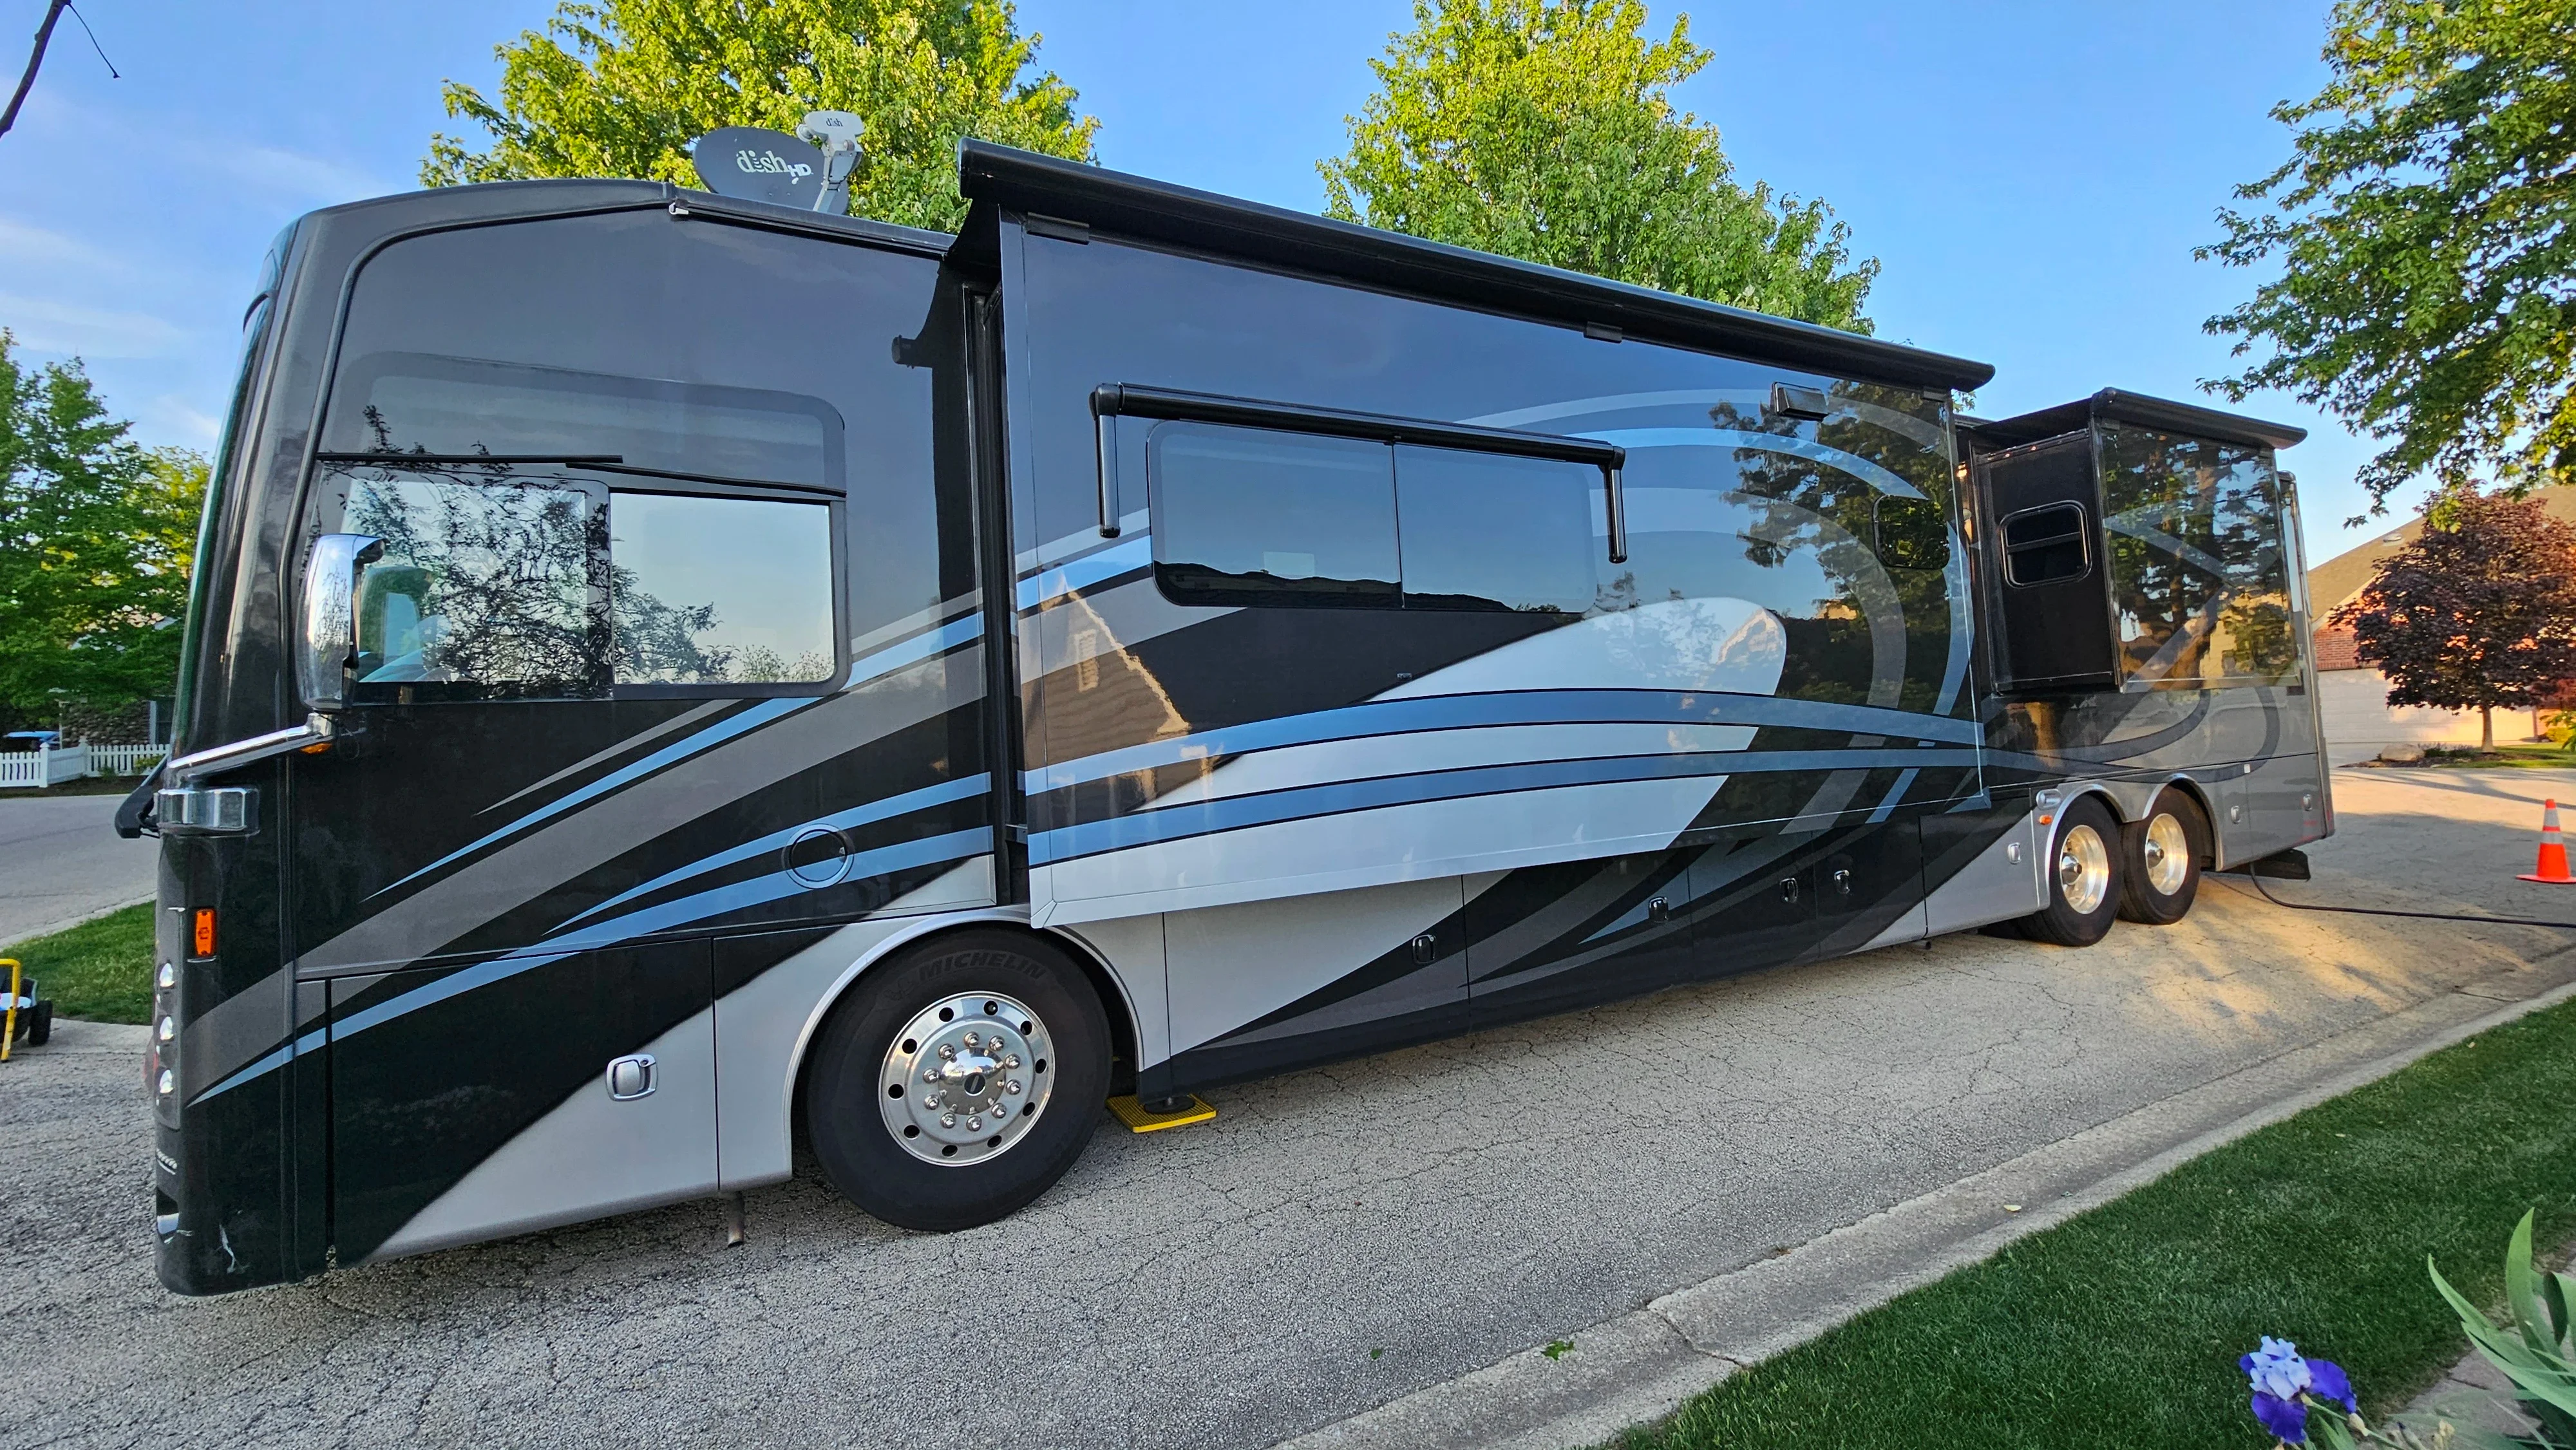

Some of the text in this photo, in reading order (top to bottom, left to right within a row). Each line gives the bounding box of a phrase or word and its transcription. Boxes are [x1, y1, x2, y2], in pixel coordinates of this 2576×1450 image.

[737, 150, 812, 177] dish HD
[918, 952, 1046, 981] MICHELIN
